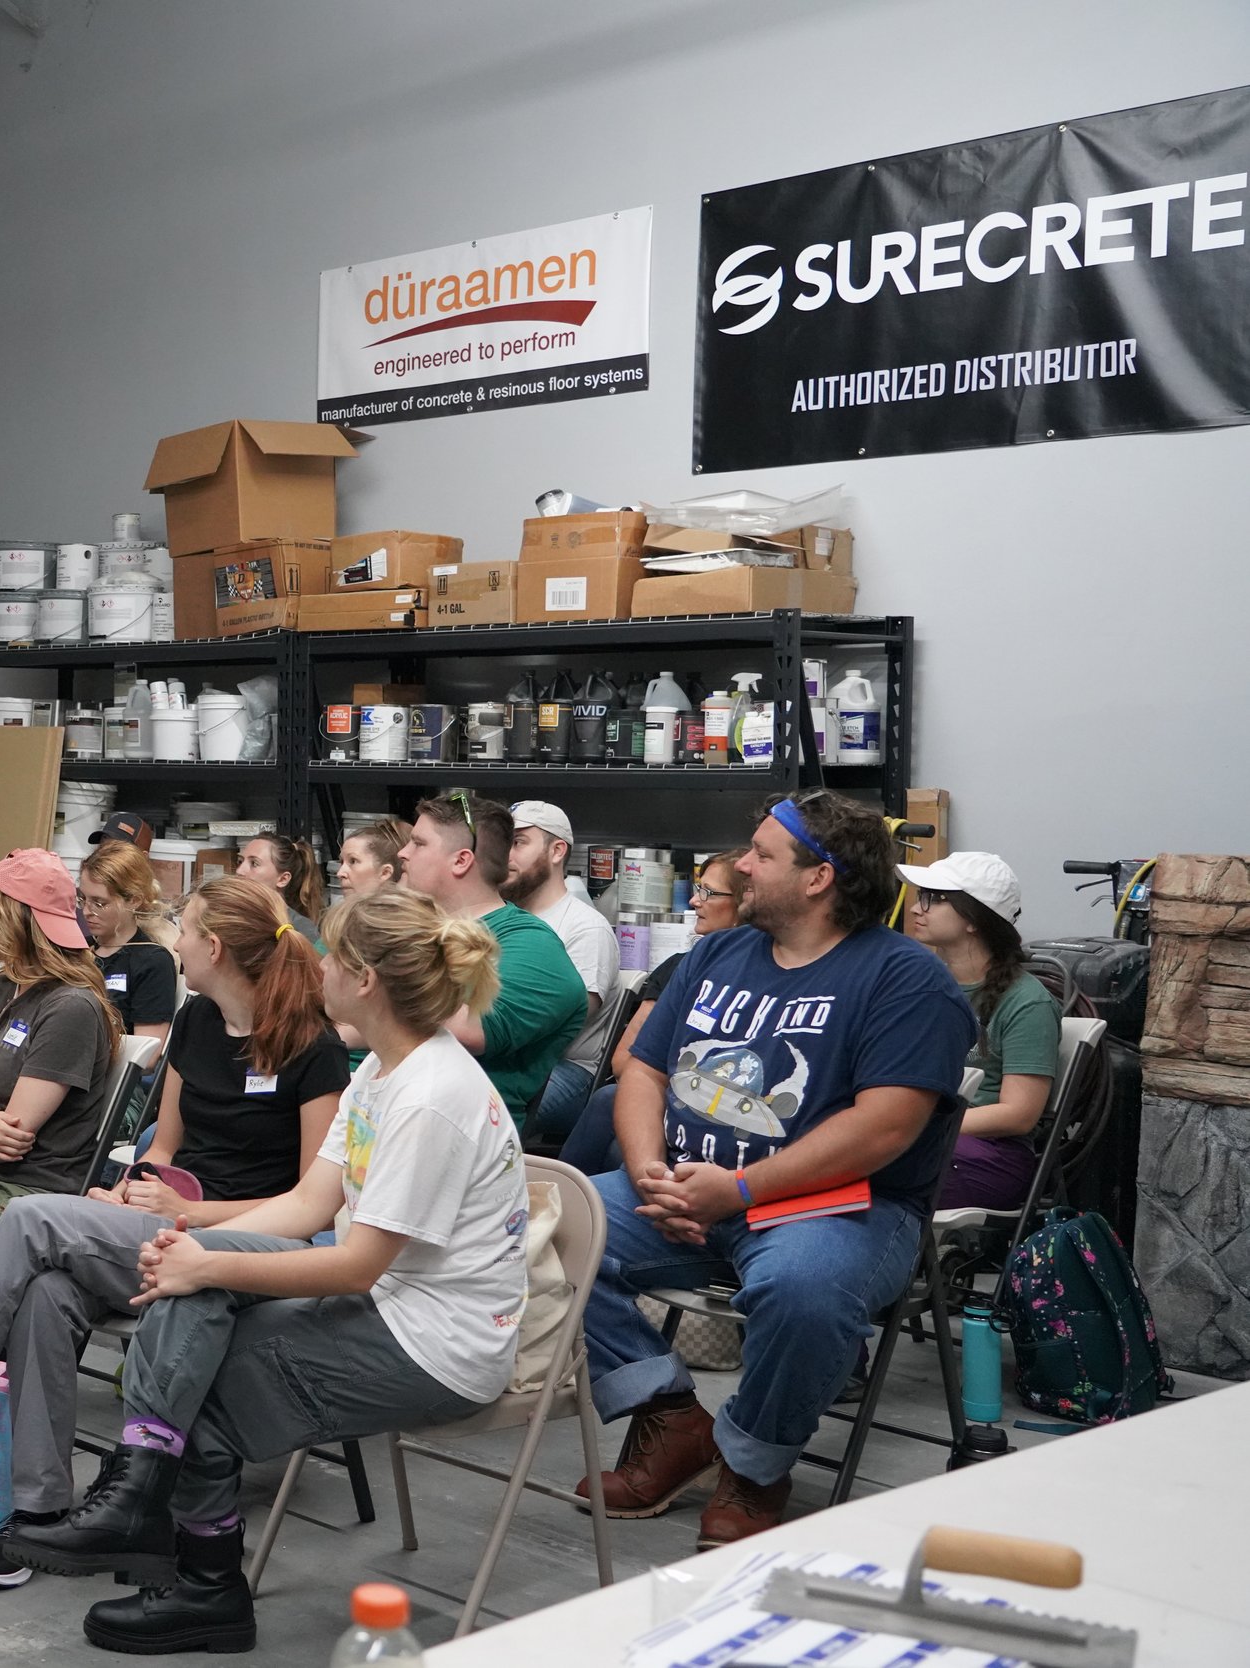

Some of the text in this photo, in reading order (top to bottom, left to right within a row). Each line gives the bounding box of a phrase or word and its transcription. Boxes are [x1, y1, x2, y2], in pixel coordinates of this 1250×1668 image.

[791, 172, 1248, 313] SURECRETE
[364, 248, 597, 325] düraamen
[373, 329, 577, 378] engineered to perform
[790, 337, 1138, 413] AUTHORIZED DISTRIBUTOR
[321, 365, 644, 422] manufacturer of concrete & resinous floor systems
[436, 604, 448, 615] 4-1
[572, 704, 607, 717] VIVID
